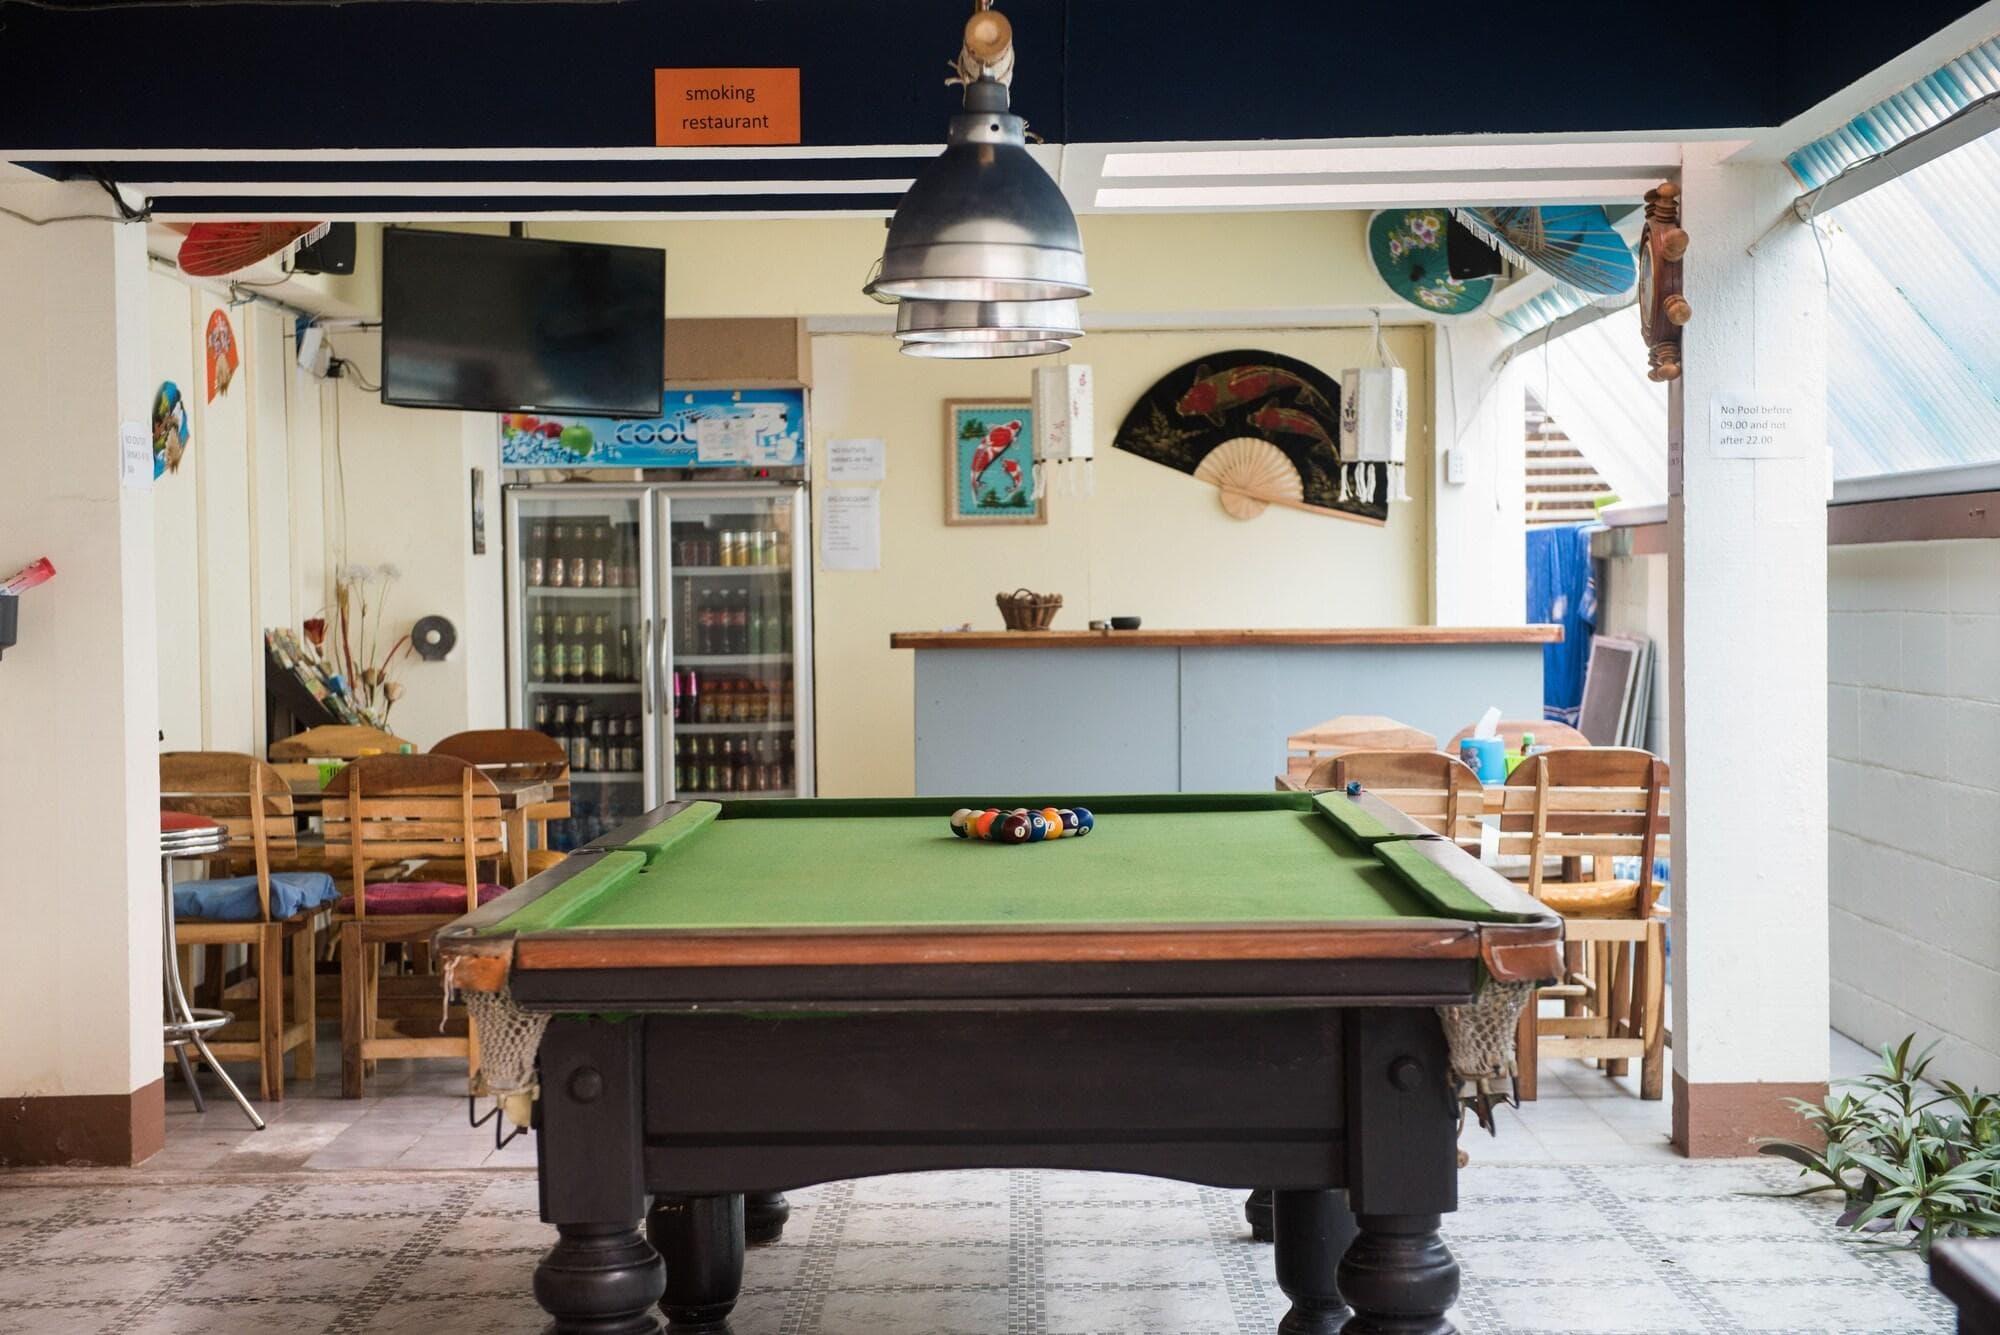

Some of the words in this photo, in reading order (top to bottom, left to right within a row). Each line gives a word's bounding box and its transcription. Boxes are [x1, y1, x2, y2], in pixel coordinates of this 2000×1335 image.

[686, 84, 756, 103] smoking
[682, 115, 769, 130] restaurant
[1720, 406, 1735, 415] No
[1737, 405, 1759, 415] Pool
[1761, 405, 1793, 415] before
[1720, 420, 1748, 430] 09.00
[1750, 420, 1768, 429] and
[1770, 421, 1787, 430] not
[1720, 436, 1744, 445] after
[1746, 435, 1773, 445] 22.00
